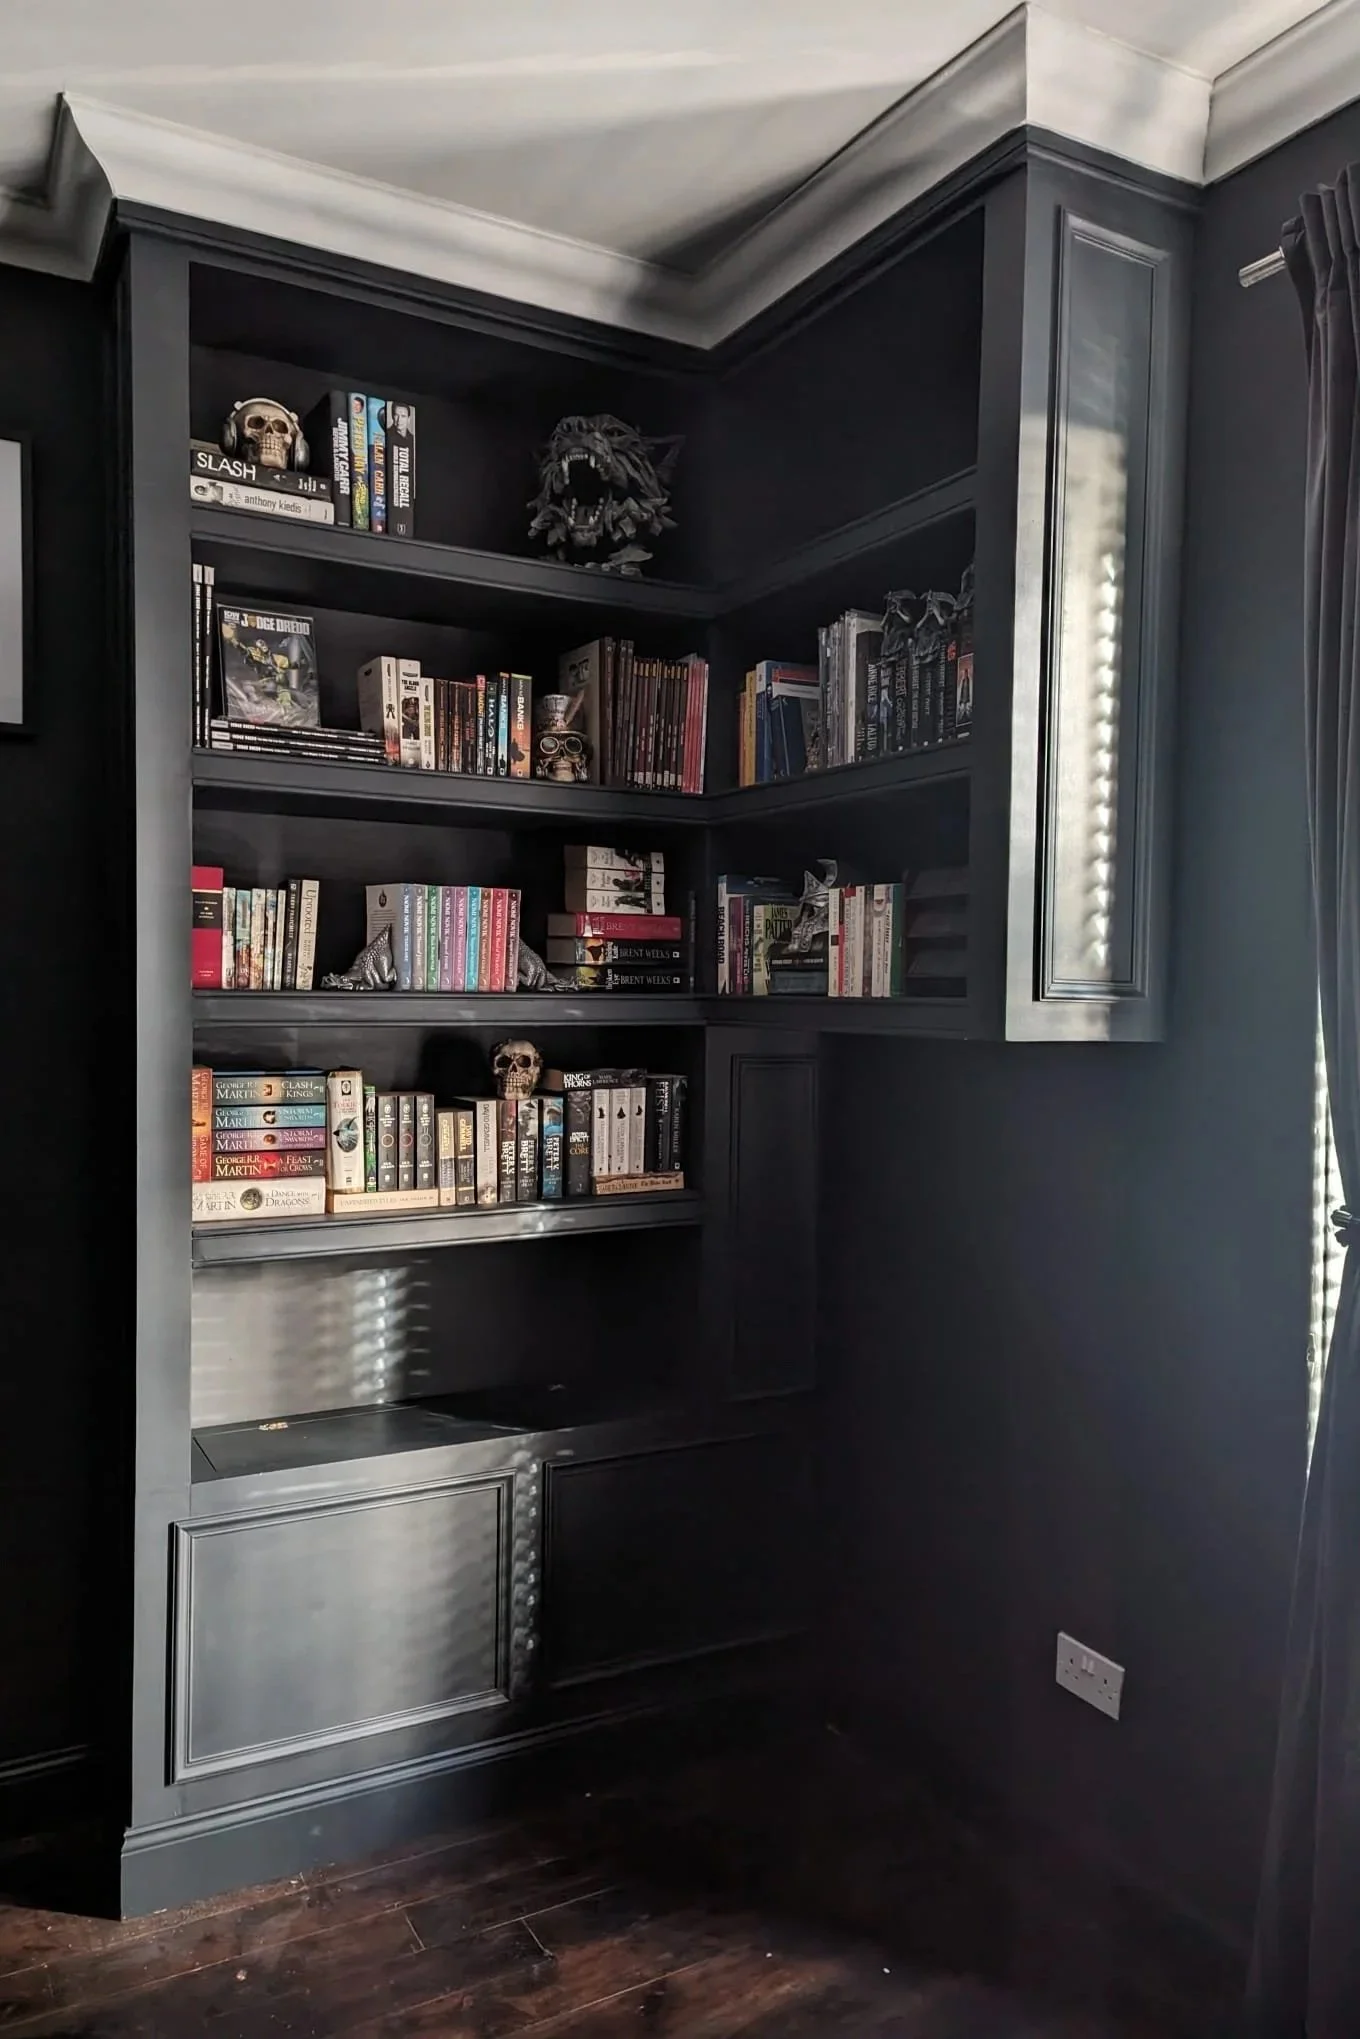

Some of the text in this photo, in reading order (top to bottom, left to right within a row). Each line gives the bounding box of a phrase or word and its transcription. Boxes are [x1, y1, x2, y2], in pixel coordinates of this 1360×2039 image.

[337, 418, 350, 495] JIMMY CARR
[196, 451, 257, 481] SLASH
[374, 470, 384, 496] CARR
[398, 446, 410, 508] TOTAL RECALL
[244, 494, 278, 511] anthony
[279, 499, 302, 514] kiedis
[276, 618, 310, 635] DREDD
[868, 664, 877, 703] ANNE RICE
[488, 698, 496, 738] HALO
[304, 889, 316, 934] Uprooted
[620, 948, 670, 959] BRENT WEEKS
[620, 976, 671, 984] BRENT WEEKS
[282, 1081, 313, 1089] CLASH
[564, 1073, 584, 1081] KING
[564, 1080, 592, 1088] THORNS
[216, 1089, 261, 1099] MARTIN
[656, 1081, 664, 1115] FEIST
[200, 1135, 208, 1169] GAME OF
[216, 1140, 259, 1150] MARTI
[216, 1156, 246, 1164] GEORGE
[520, 1140, 529, 1173] BRETT
[216, 1164, 262, 1176] MARTIN
[193, 1201, 236, 1211] MARTIN
[266, 1198, 309, 1207] DRAGONS
